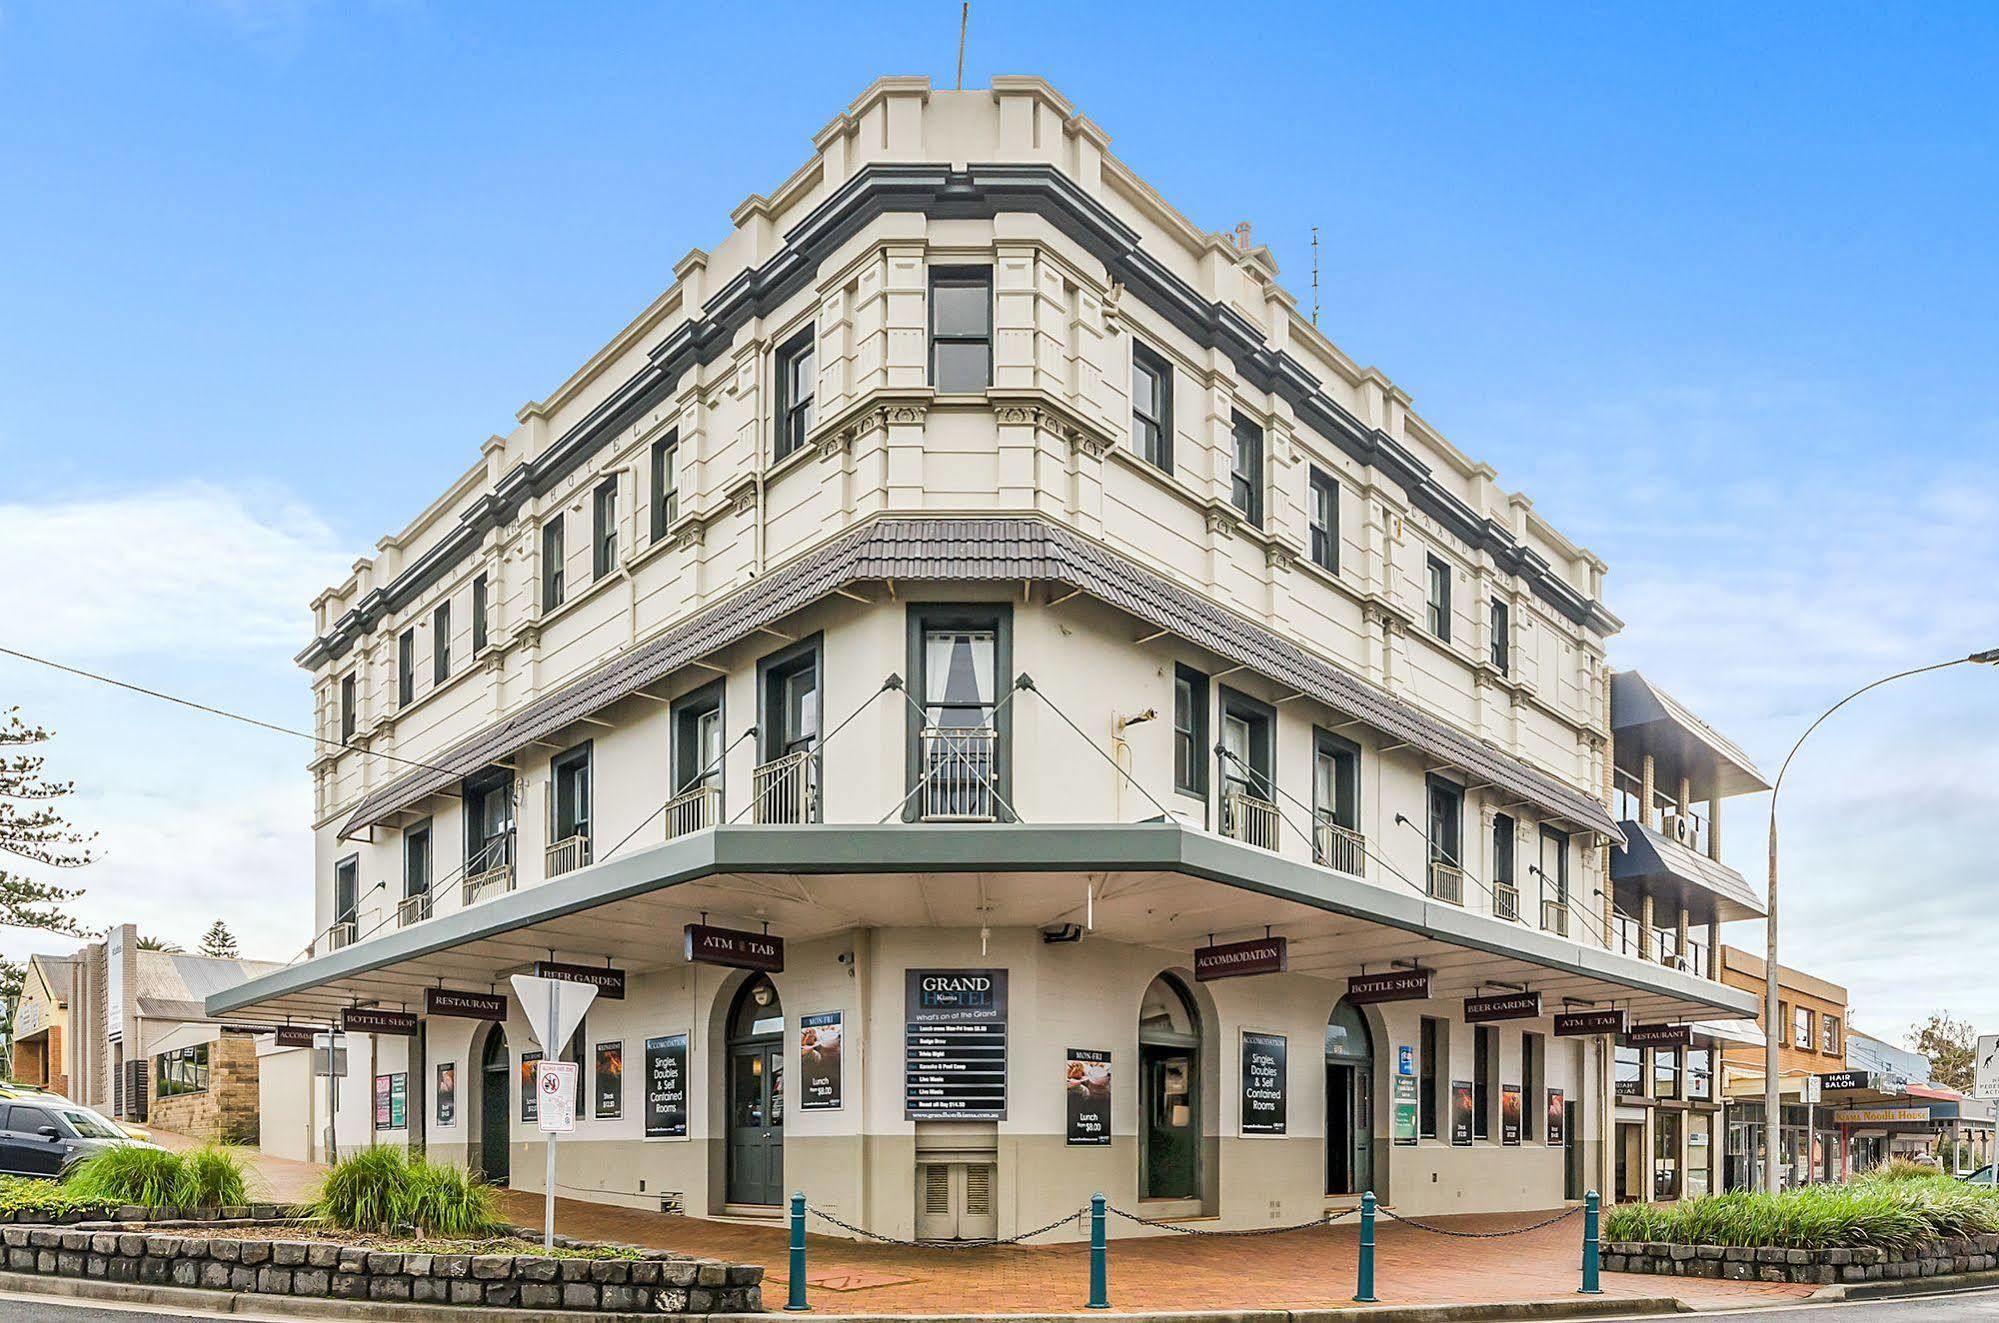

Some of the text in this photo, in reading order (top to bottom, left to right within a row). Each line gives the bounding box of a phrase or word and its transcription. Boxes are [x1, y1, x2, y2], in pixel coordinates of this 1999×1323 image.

[703, 935, 775, 956] ATM TAB
[1197, 947, 1279, 967] ACCOMMODATION
[574, 974, 622, 987] GARDEN
[922, 977, 990, 992] GRAND
[1351, 977, 1426, 994] BOTTLE SHOP
[435, 996, 501, 1010] RESTAURANT
[1467, 998, 1536, 1013] BEER GARDEN
[346, 1015, 416, 1028] BOTTLE SHOP
[1596, 1016, 1616, 1024] TAB
[1632, 1030, 1686, 1040] RESTAURANT
[654, 1068, 679, 1080] Doubles
[1250, 1065, 1277, 1076] Doubles
[657, 1079, 675, 1090] & Self
[812, 1078, 829, 1086] Lunch
[1254, 1077, 1274, 1088] & Self
[650, 1090, 683, 1102] Contained
[1246, 1088, 1281, 1100] Contained
[656, 1104, 677, 1113] Rooms
[1252, 1100, 1275, 1111] Rooms
